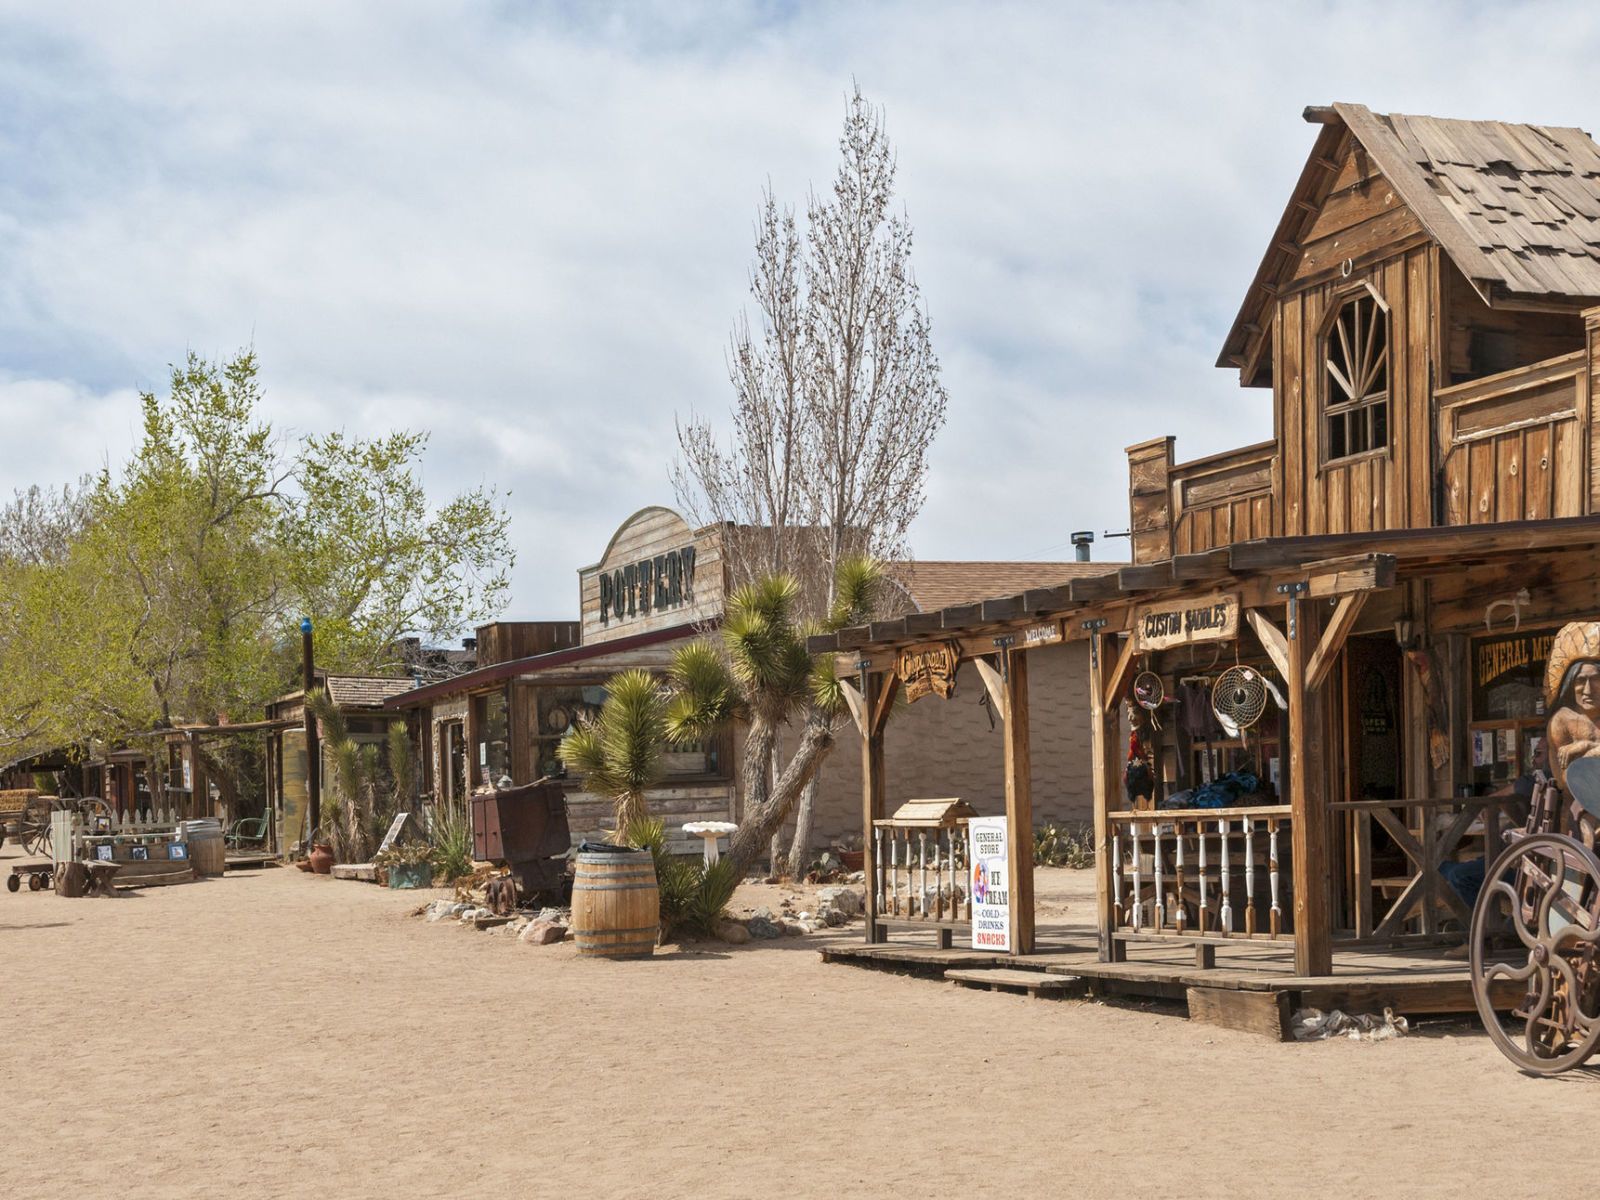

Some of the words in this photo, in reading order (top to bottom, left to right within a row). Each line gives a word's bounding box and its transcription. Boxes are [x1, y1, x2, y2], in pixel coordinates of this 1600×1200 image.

[599, 546, 696, 626] POTTERY
[1145, 611, 1182, 638] CUSTOM
[1185, 603, 1226, 631] SADDLES
[1025, 624, 1056, 643] WELCOME
[1478, 639, 1528, 688] GENERAL
[976, 832, 1003, 842] GENERAL
[980, 844, 999, 854] STORE
[991, 871, 1001, 885] ICE
[985, 890, 1008, 905] CREAM
[981, 909, 1000, 918] COLD
[978, 920, 1004, 930] DRINKS
[977, 932, 1006, 945] SNACKS
